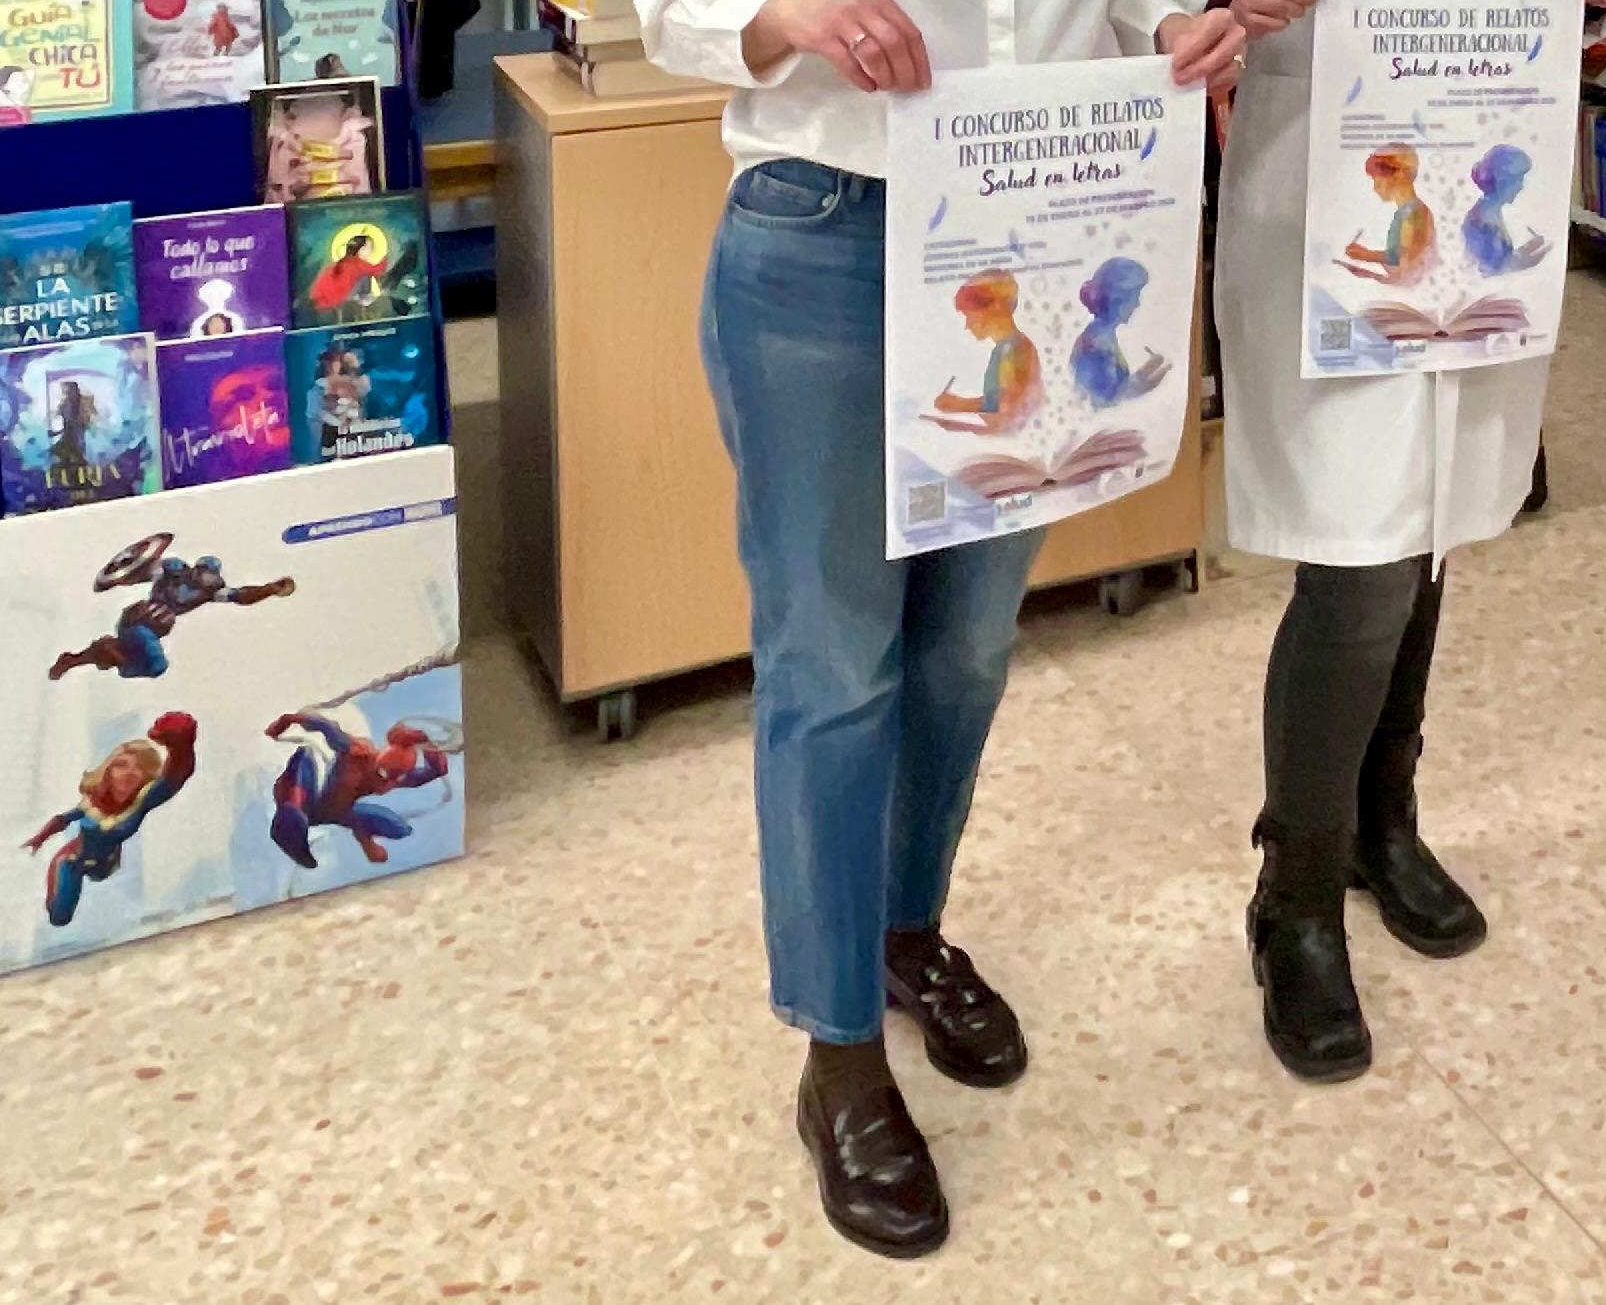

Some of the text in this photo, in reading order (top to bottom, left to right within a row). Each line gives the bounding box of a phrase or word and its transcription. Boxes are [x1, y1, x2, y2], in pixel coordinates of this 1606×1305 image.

[1367, 8, 1450, 29] CONCURSO
[1459, 9, 1477, 28] DE
[1486, 7, 1550, 27] RELATOS
[1373, 33, 1528, 54] INTERGENERACIONAL
[1390, 57, 1512, 80] Salud en letras
[935, 97, 1165, 140] I CONCURSO DE RELATOS
[959, 128, 1143, 167] INTERGENERACIONAL
[979, 161, 1122, 196] Salud en letras
[36, 277, 70, 298] LA
[24, 317, 91, 344] ALAS
